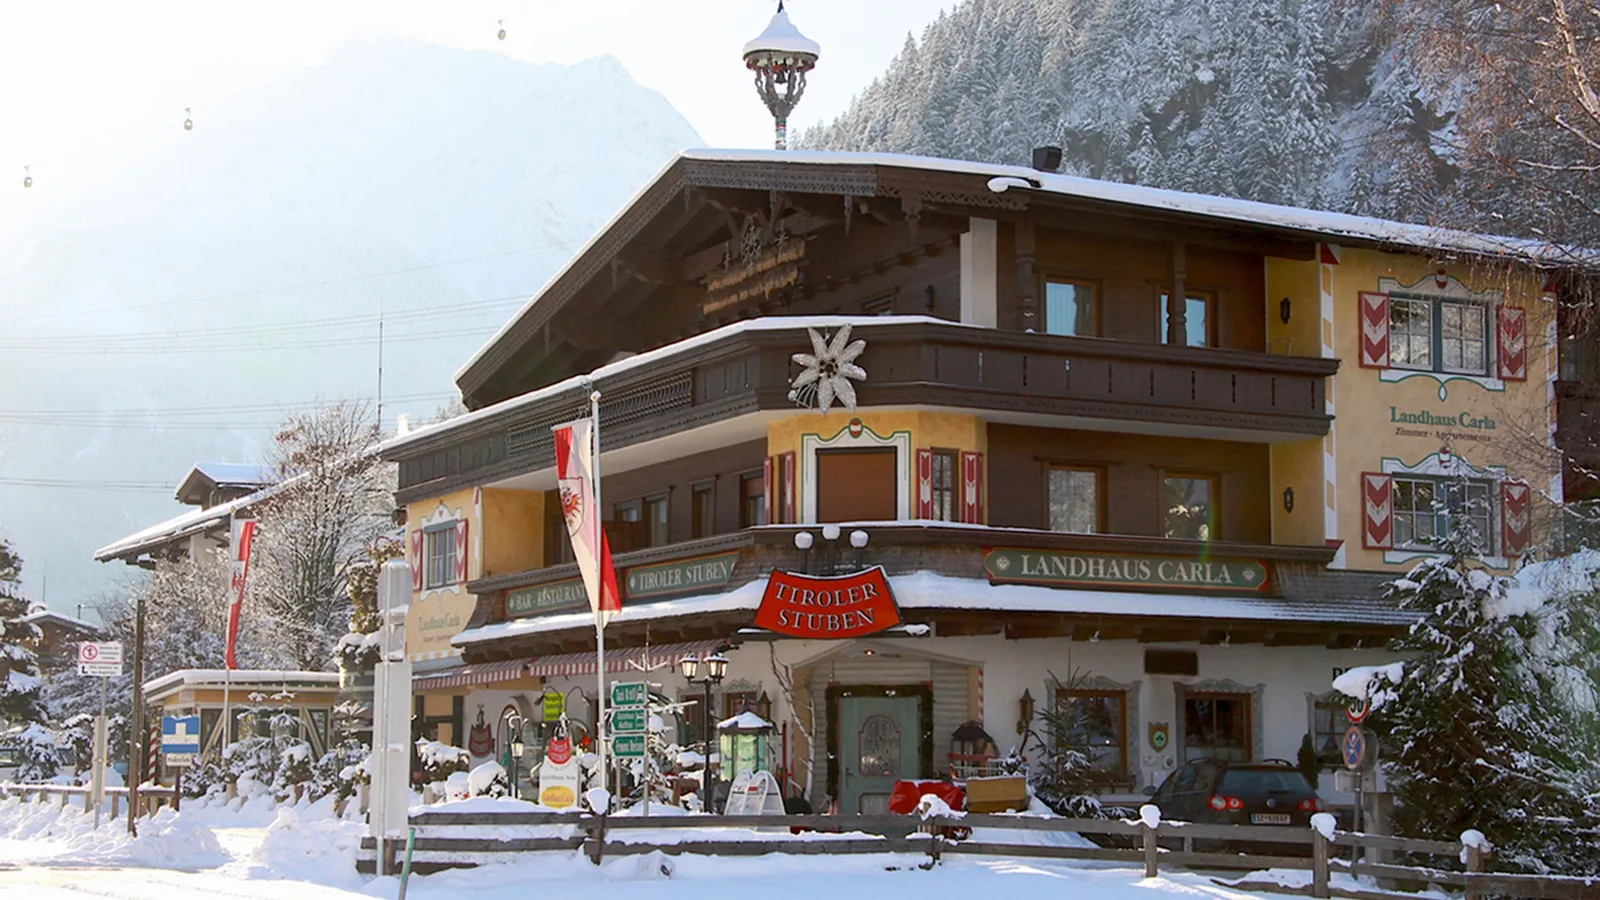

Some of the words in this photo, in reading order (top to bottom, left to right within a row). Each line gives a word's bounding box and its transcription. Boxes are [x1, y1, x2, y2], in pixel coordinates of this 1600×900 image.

[1389, 406, 1457, 426] Landhaus
[1459, 411, 1496, 429] Carla
[1395, 427, 1428, 437] Zimmer
[639, 568, 682, 591] TIROLER
[685, 560, 728, 584] STUBEN
[1020, 554, 1151, 581] LANDHAUS
[1157, 560, 1234, 584] CARLA
[516, 593, 532, 610] BAR
[775, 581, 880, 608] TIROLER
[777, 607, 875, 631] STUBEN
